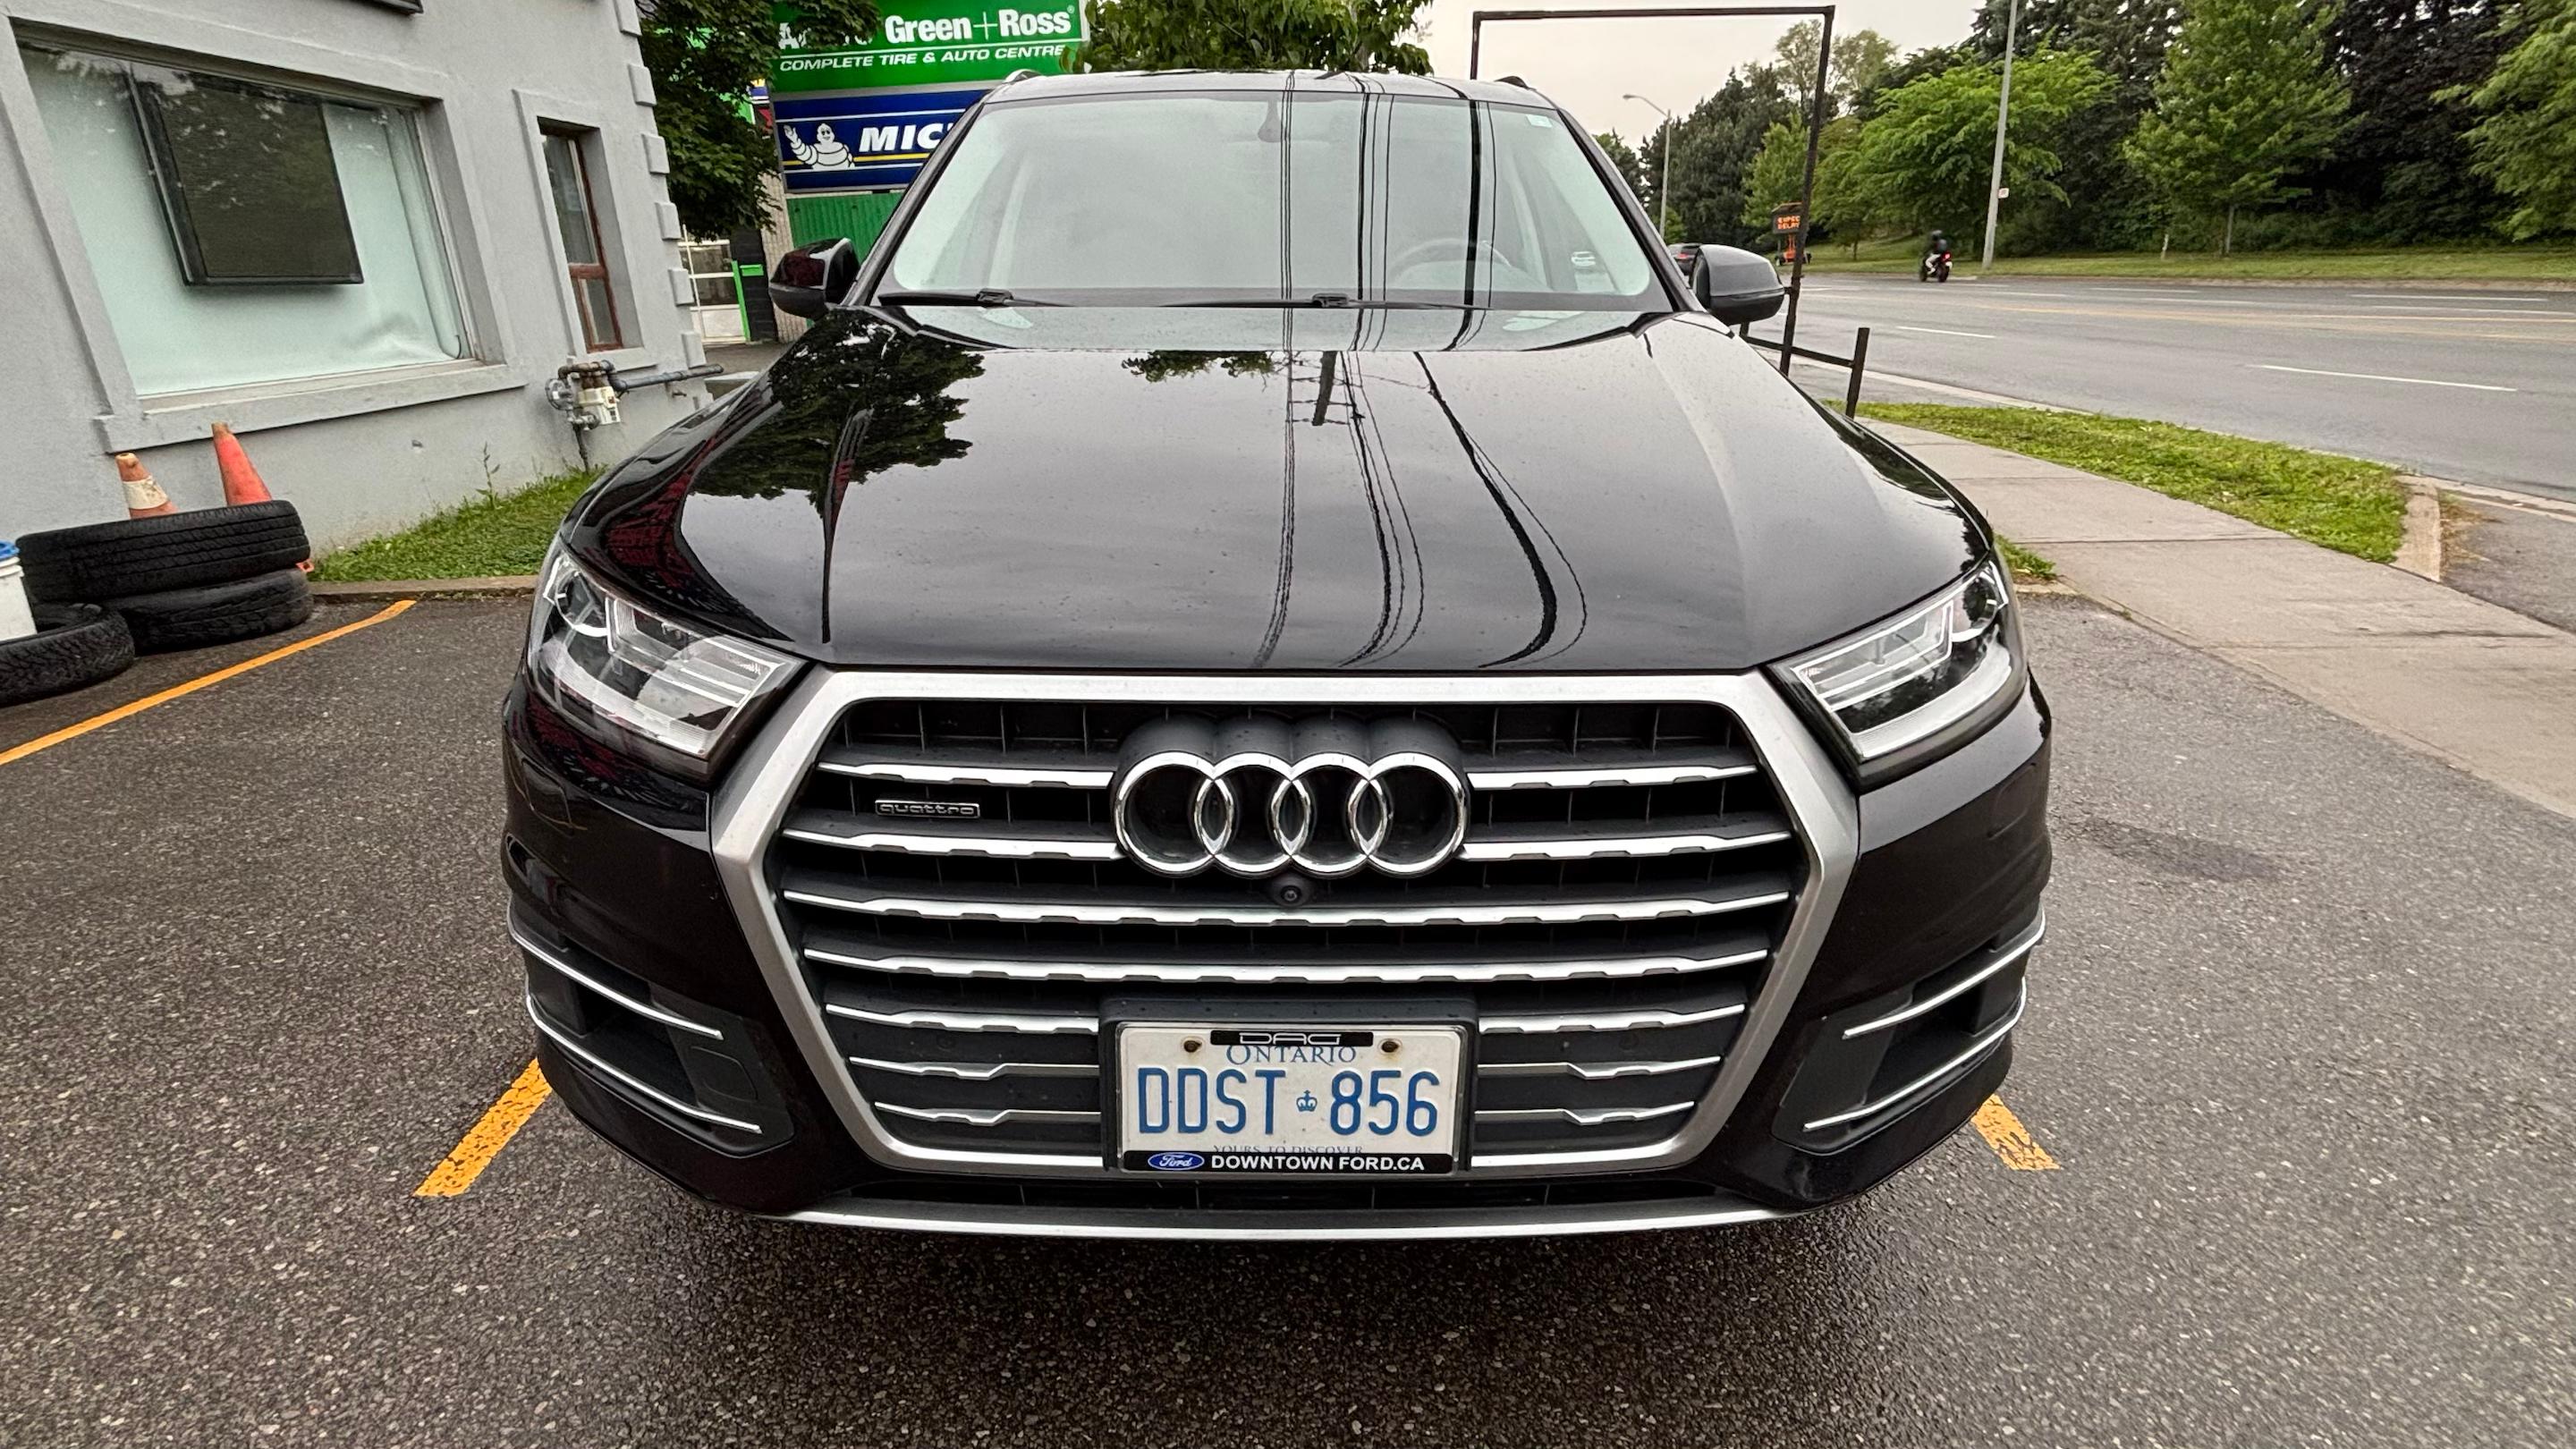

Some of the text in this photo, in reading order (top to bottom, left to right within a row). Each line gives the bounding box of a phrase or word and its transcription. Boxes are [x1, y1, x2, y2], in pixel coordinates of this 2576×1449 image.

[780, 44, 1066, 72] COMPLETE TIRE & AUTO CENTRE
[859, 122, 953, 152] MIC
[879, 803, 974, 815] quattro
[1138, 1068, 1440, 1137] DDST 856
[1159, 1154, 1425, 1171] Ford DOWNTOWN FORD.CA
